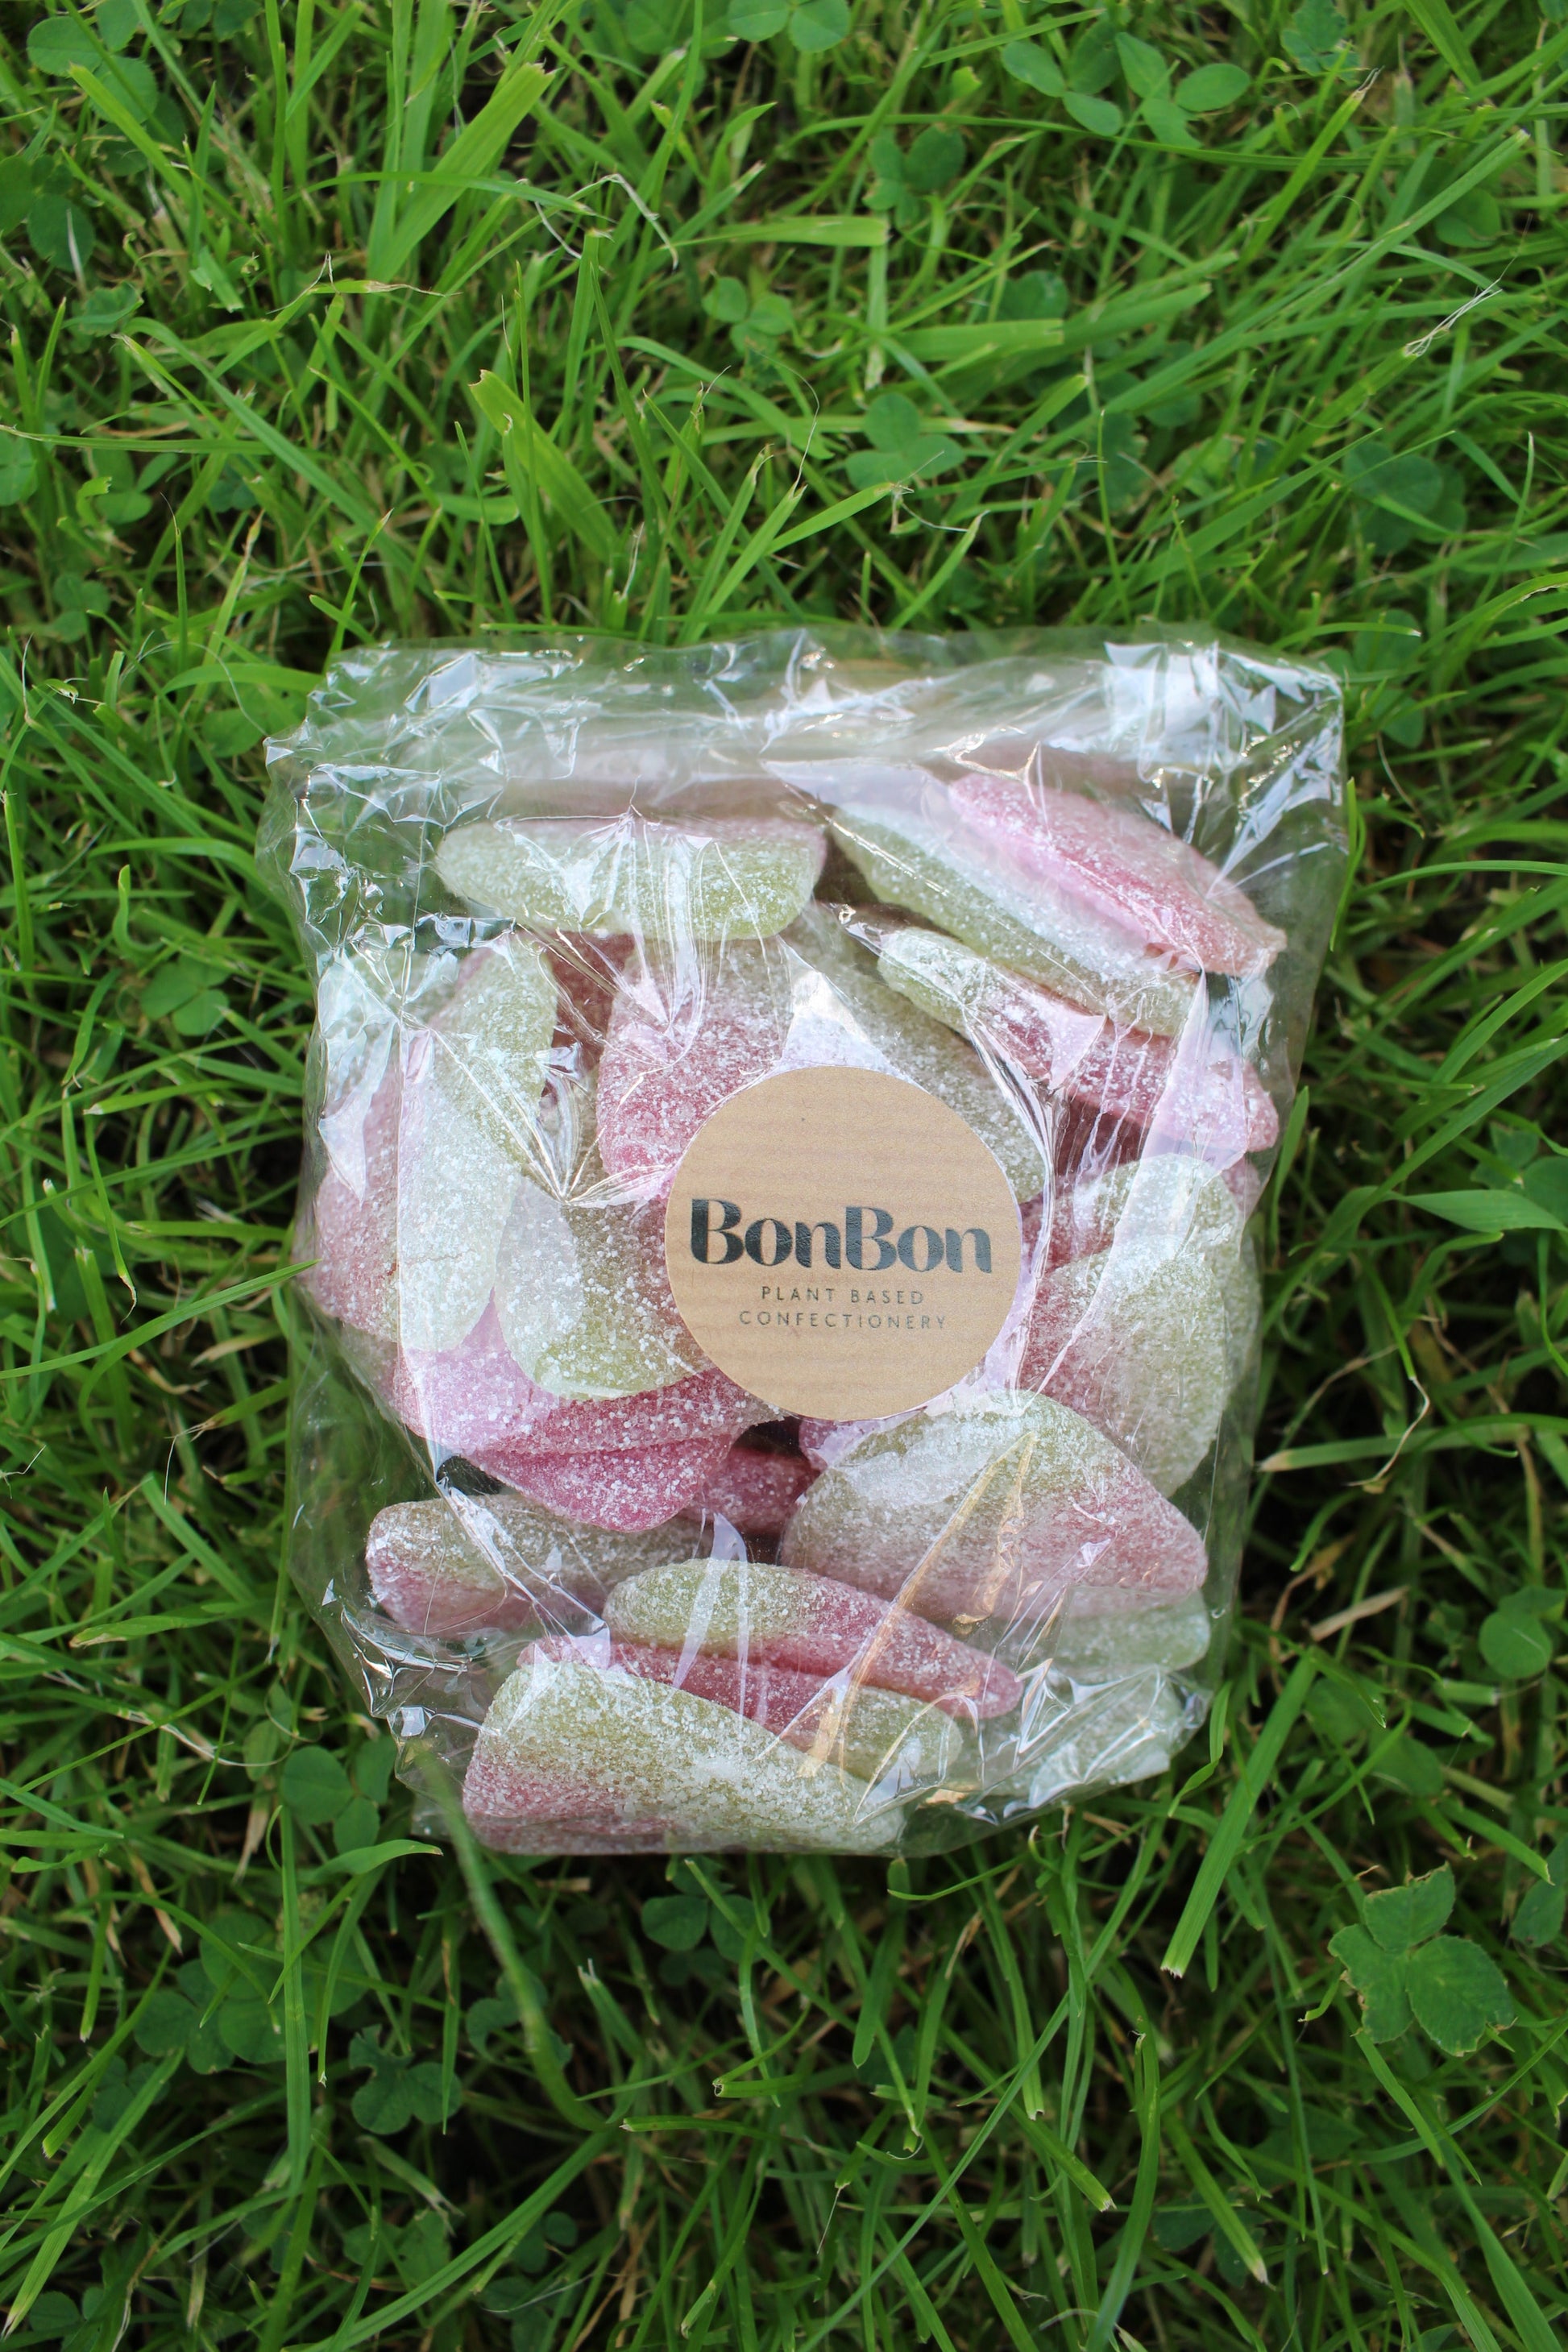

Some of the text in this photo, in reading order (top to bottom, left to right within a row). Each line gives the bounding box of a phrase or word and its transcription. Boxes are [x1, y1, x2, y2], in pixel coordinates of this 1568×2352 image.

[691, 1198, 993, 1274] BonBon
[761, 1286, 924, 1305] PLANT BASED
[739, 1311, 946, 1329] CONFECTIONERY
